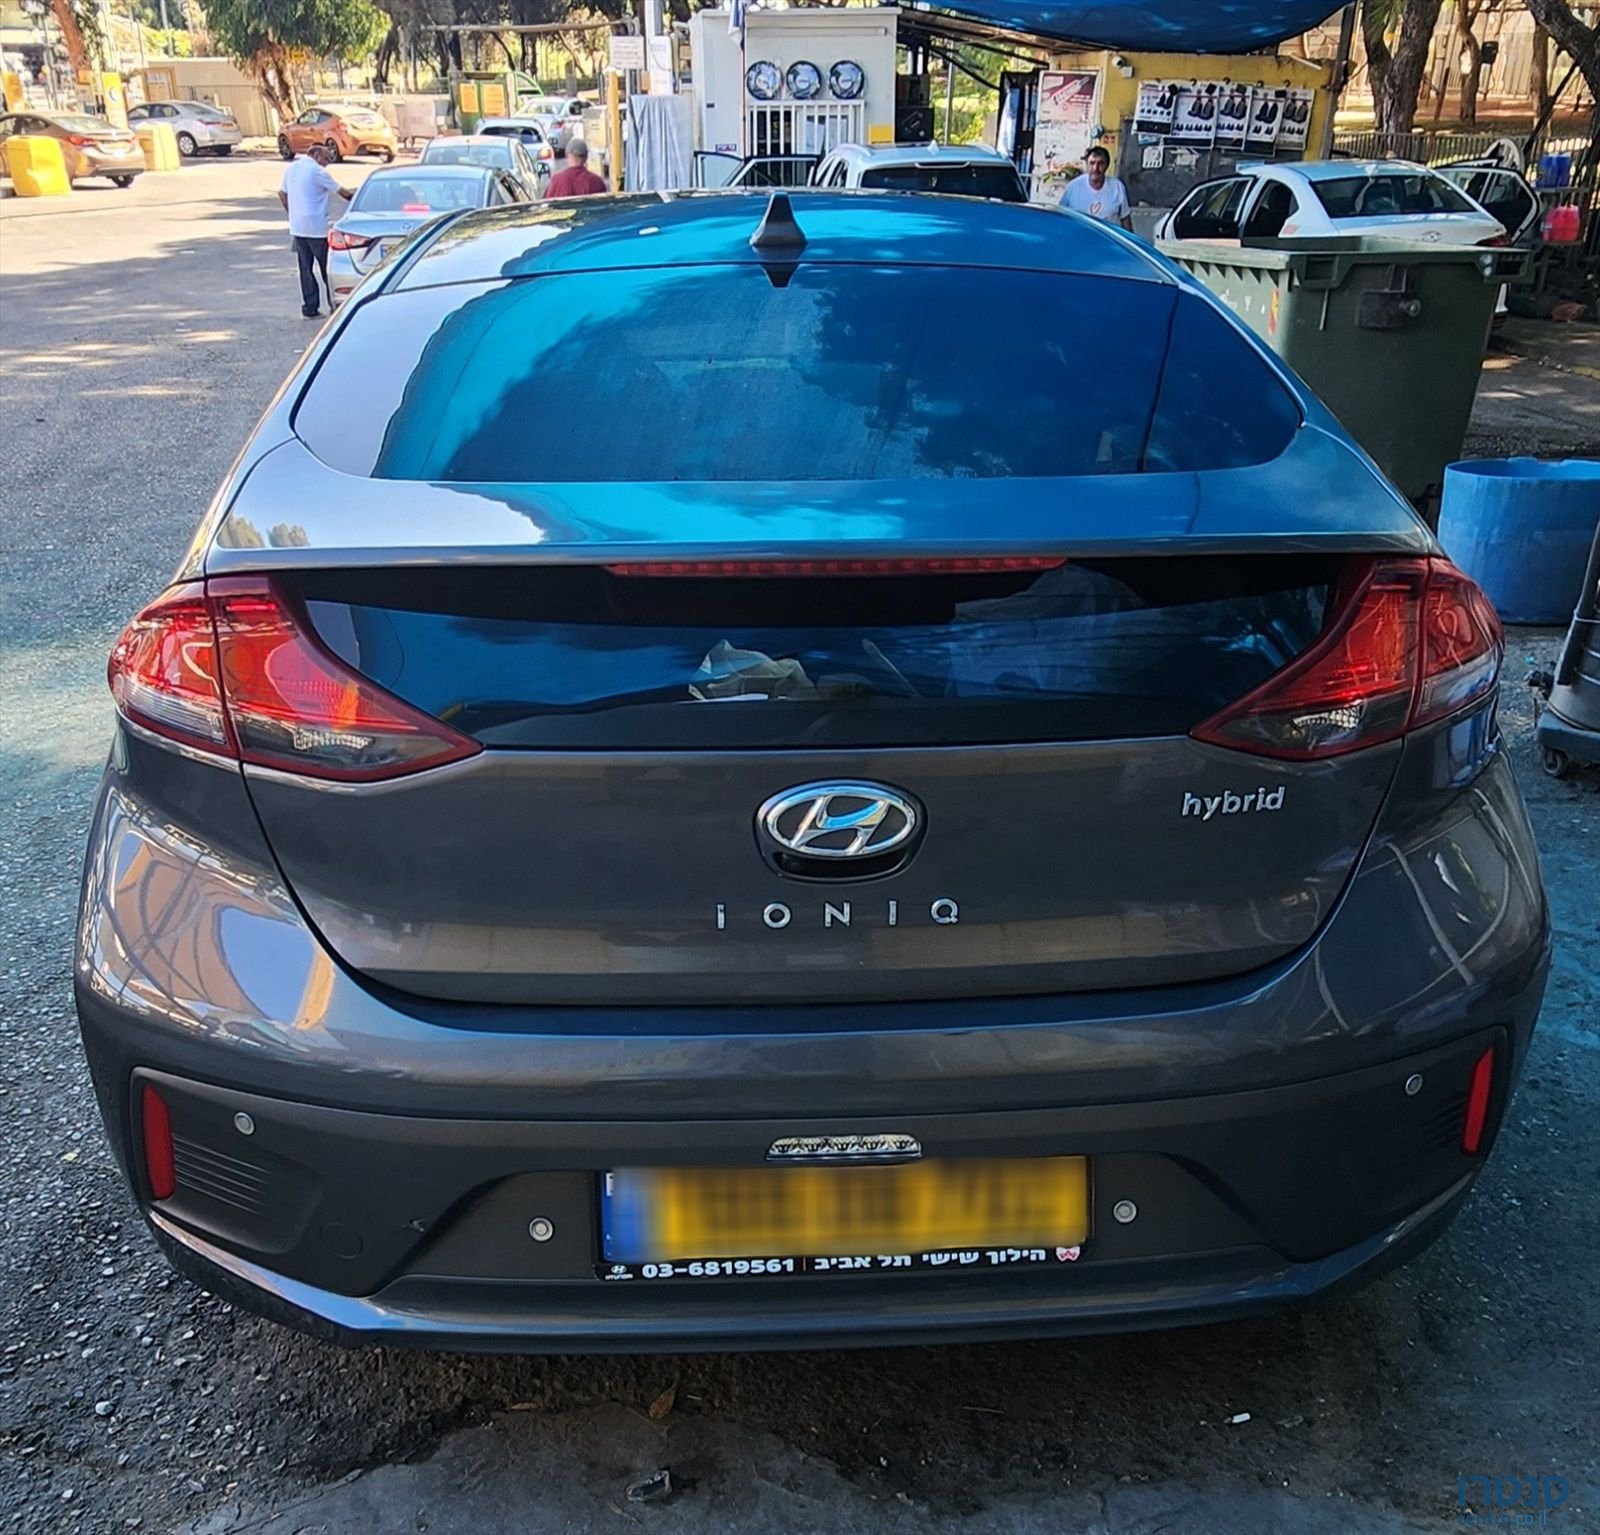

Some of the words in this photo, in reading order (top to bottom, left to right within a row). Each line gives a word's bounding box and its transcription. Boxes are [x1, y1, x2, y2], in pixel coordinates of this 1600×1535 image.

[1182, 786, 1285, 820] hybrid
[716, 898, 959, 929] IONIQ
[814, 1256, 872, 1270] אביב
[877, 1255, 911, 1267] תל
[922, 1251, 979, 1266] שישי
[985, 1249, 1046, 1265] הילוך
[641, 1258, 794, 1278] 03-6819561
